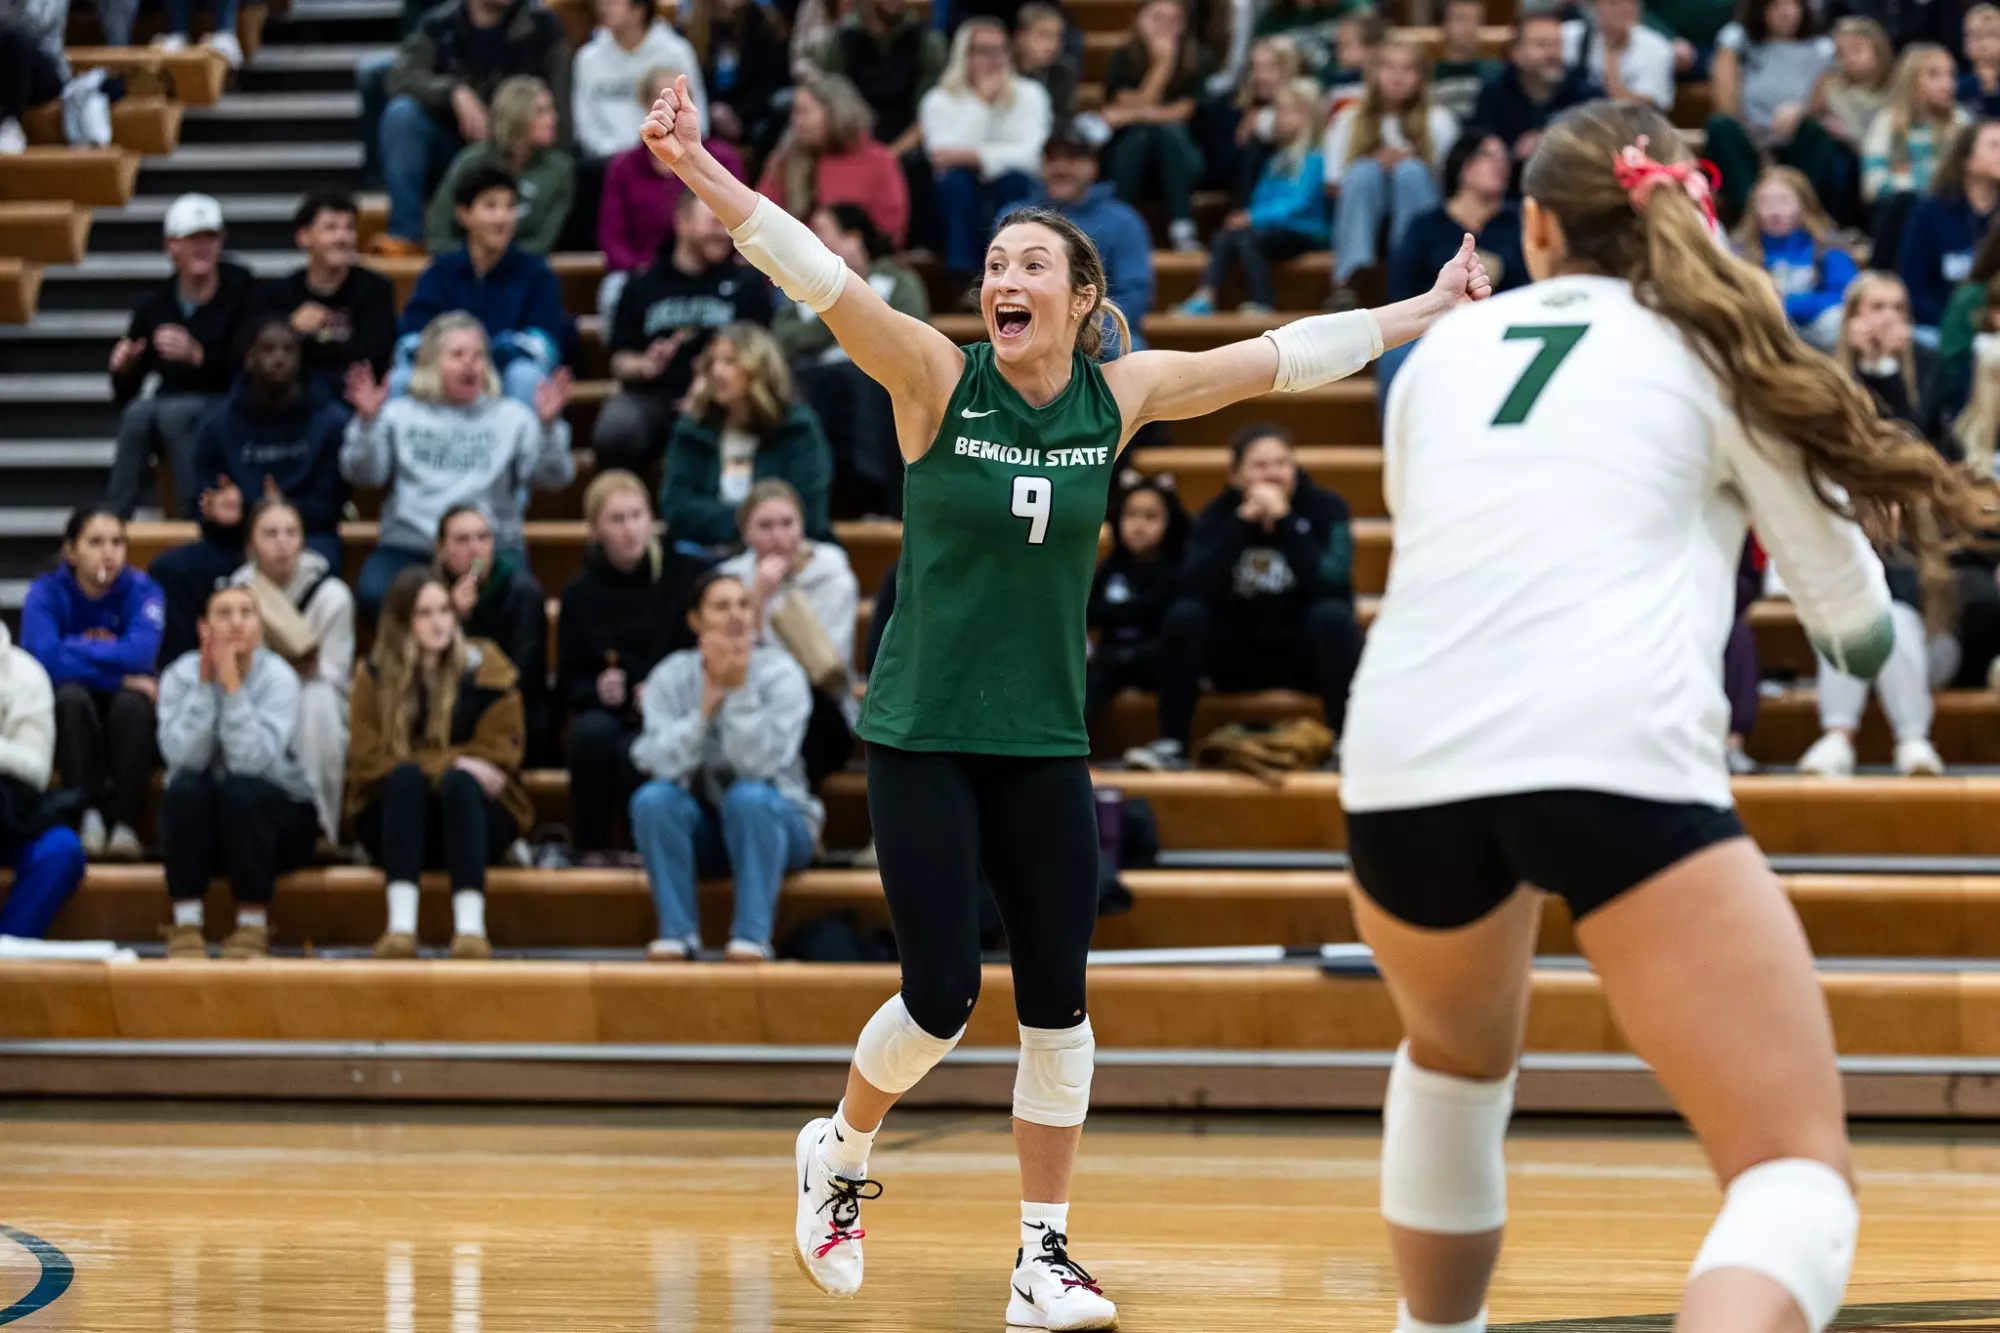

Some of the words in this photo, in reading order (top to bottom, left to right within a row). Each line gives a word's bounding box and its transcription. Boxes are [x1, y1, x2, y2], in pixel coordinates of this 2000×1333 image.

[1491, 324, 1590, 425] 7
[954, 436, 1040, 466] BEMIDJI
[1045, 446, 1108, 467] STATE
[1010, 475, 1053, 545] 9
